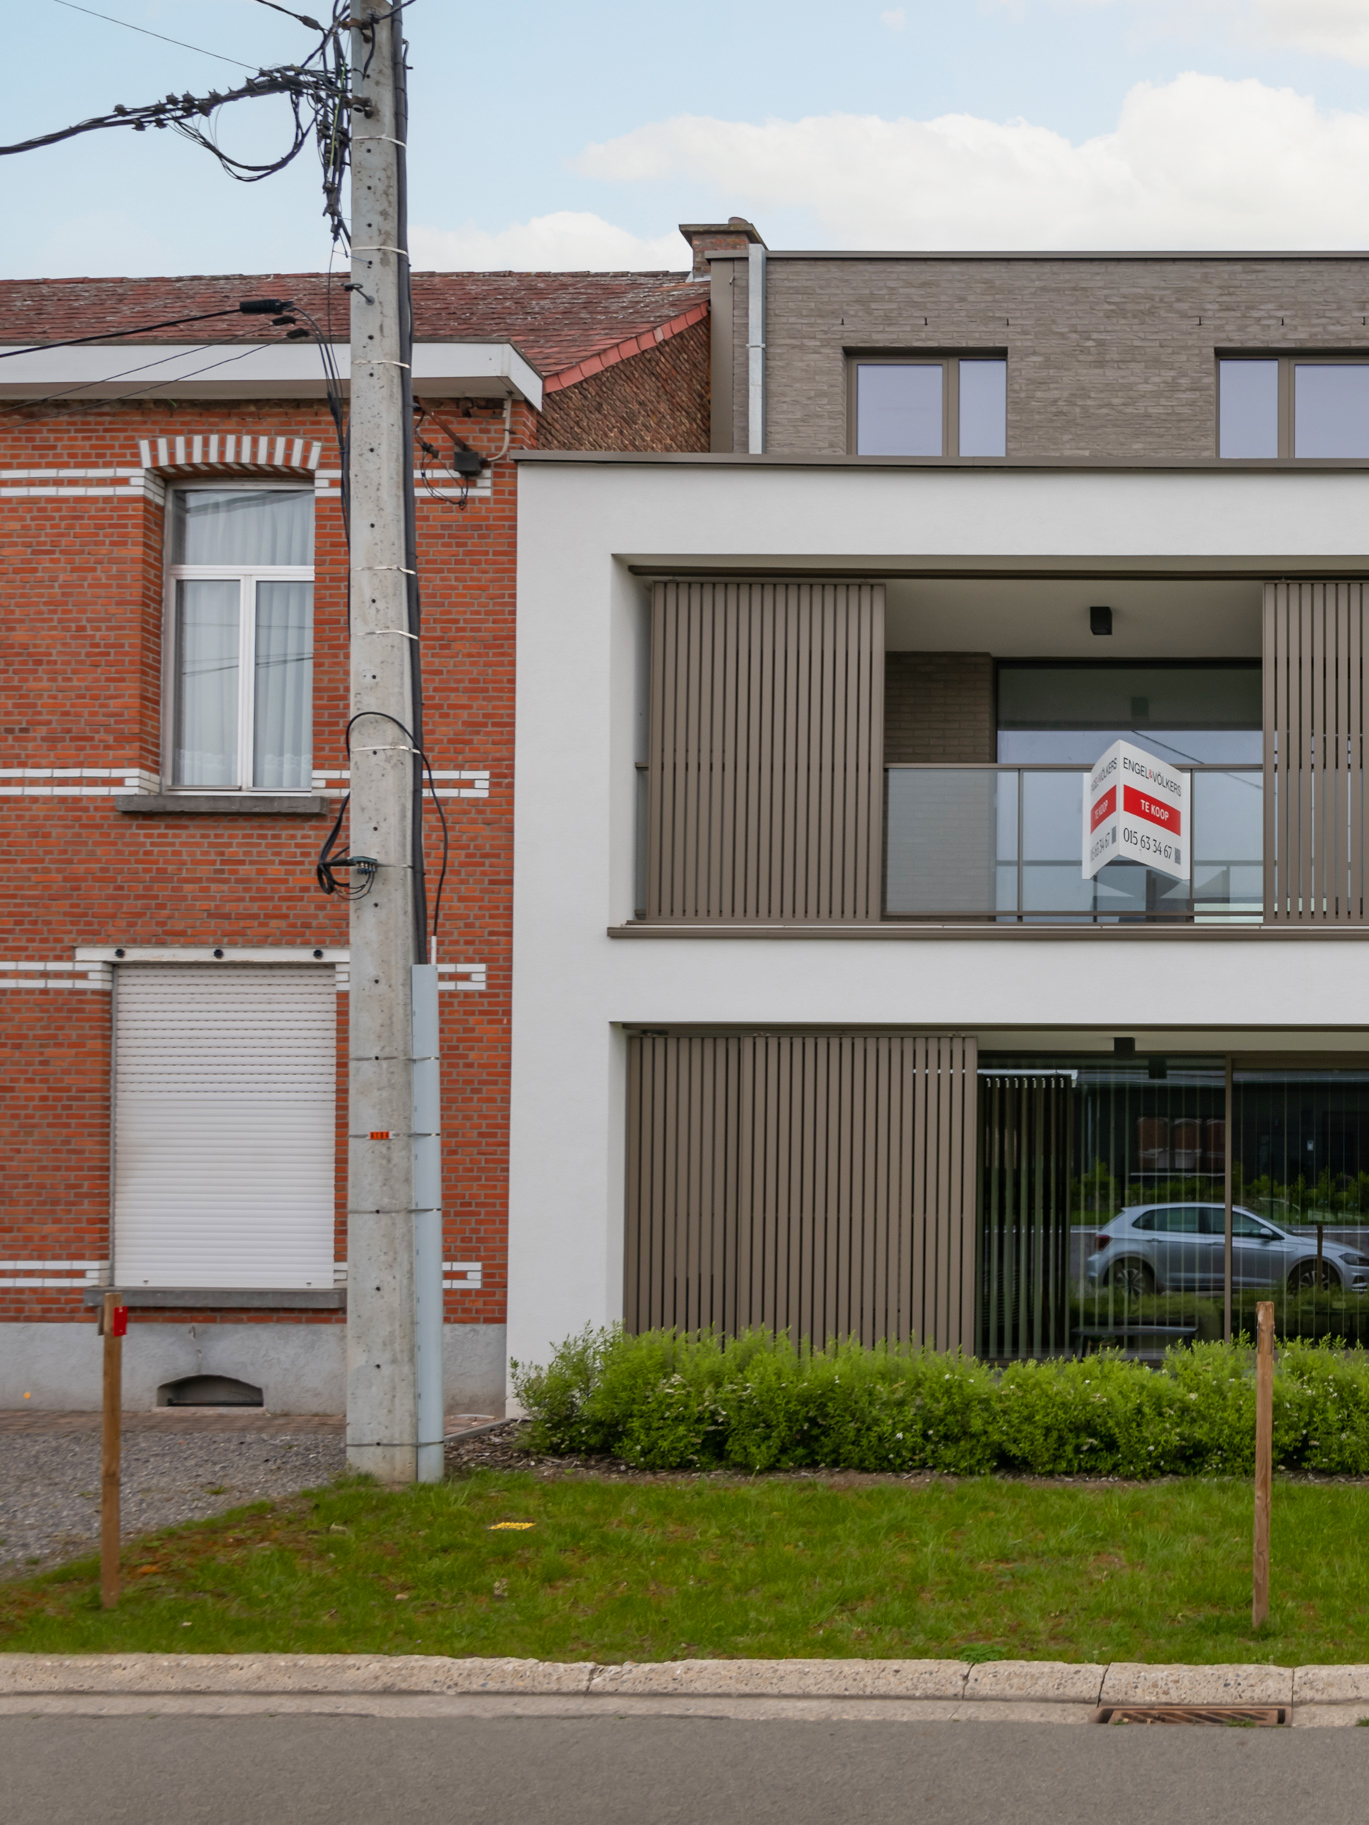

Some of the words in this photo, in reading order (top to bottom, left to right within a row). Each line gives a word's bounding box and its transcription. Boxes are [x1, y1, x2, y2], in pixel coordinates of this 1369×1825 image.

[1123, 757, 1182, 797] ENGEL&VÖLKERS
[1140, 799, 1149, 813] TE
[1151, 804, 1170, 821] KOOP
[1123, 827, 1138, 846] 015
[1140, 834, 1151, 851] 63
[1152, 838, 1162, 856] 34
[1164, 844, 1173, 860] 67
